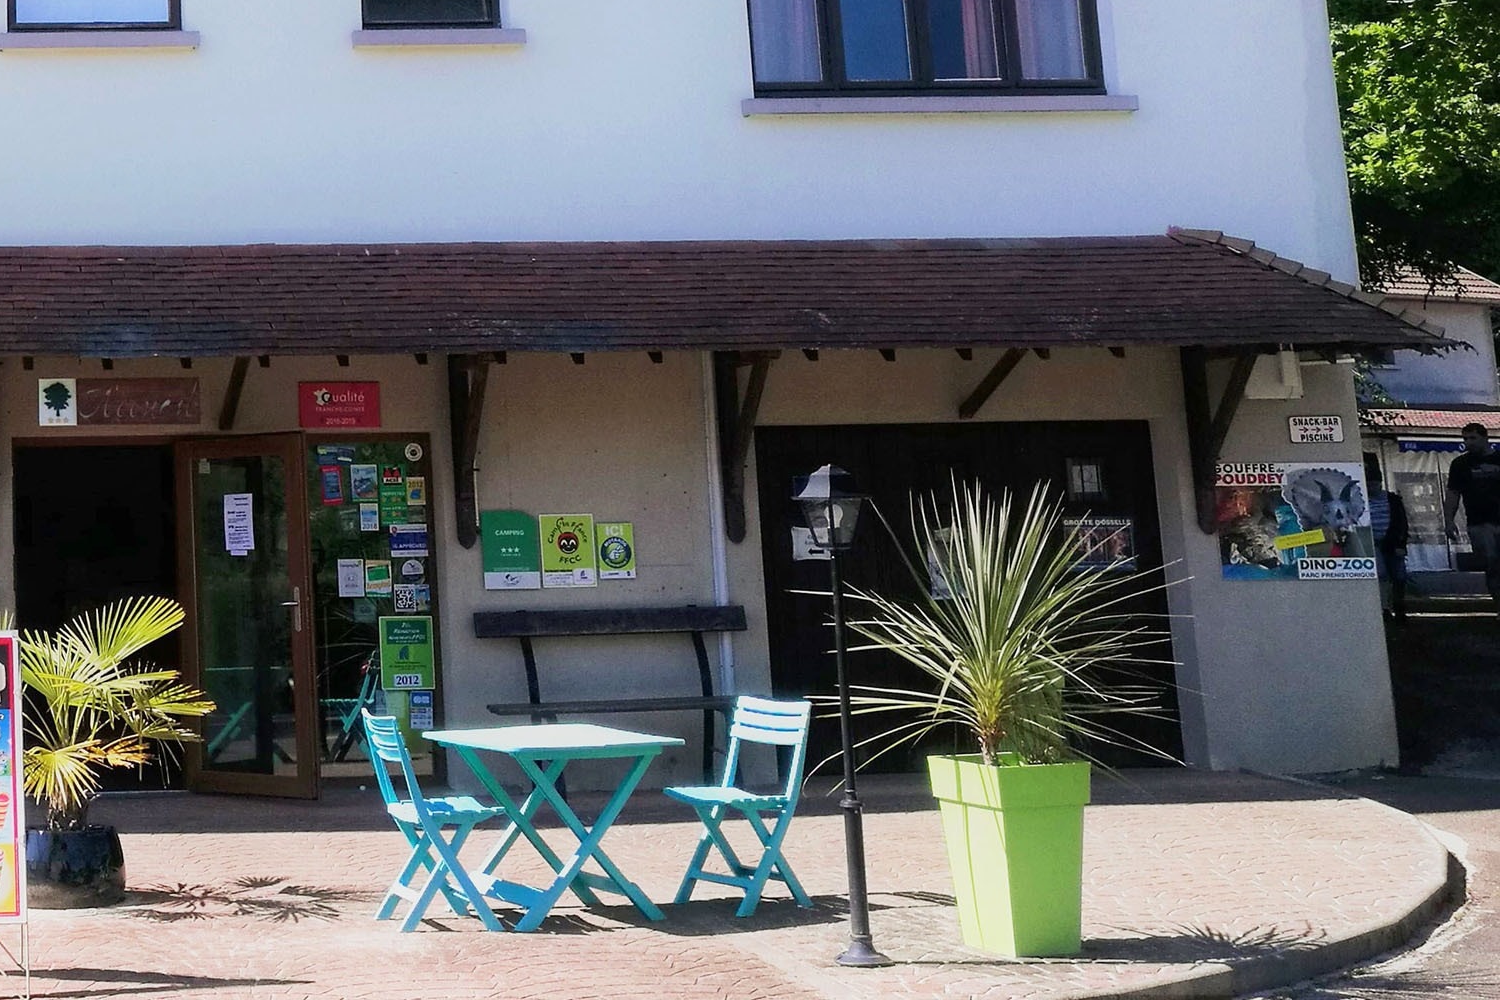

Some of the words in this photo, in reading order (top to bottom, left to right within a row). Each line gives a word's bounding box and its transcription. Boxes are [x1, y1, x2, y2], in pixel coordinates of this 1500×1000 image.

[1292, 417, 1339, 427] SNACK-BAR
[1300, 433, 1334, 442] PISCINE
[1215, 473, 1284, 484] POUDREY
[605, 526, 623, 536] ICI
[1300, 559, 1375, 570] DINO-ZOO
[396, 675, 419, 685] 2012
